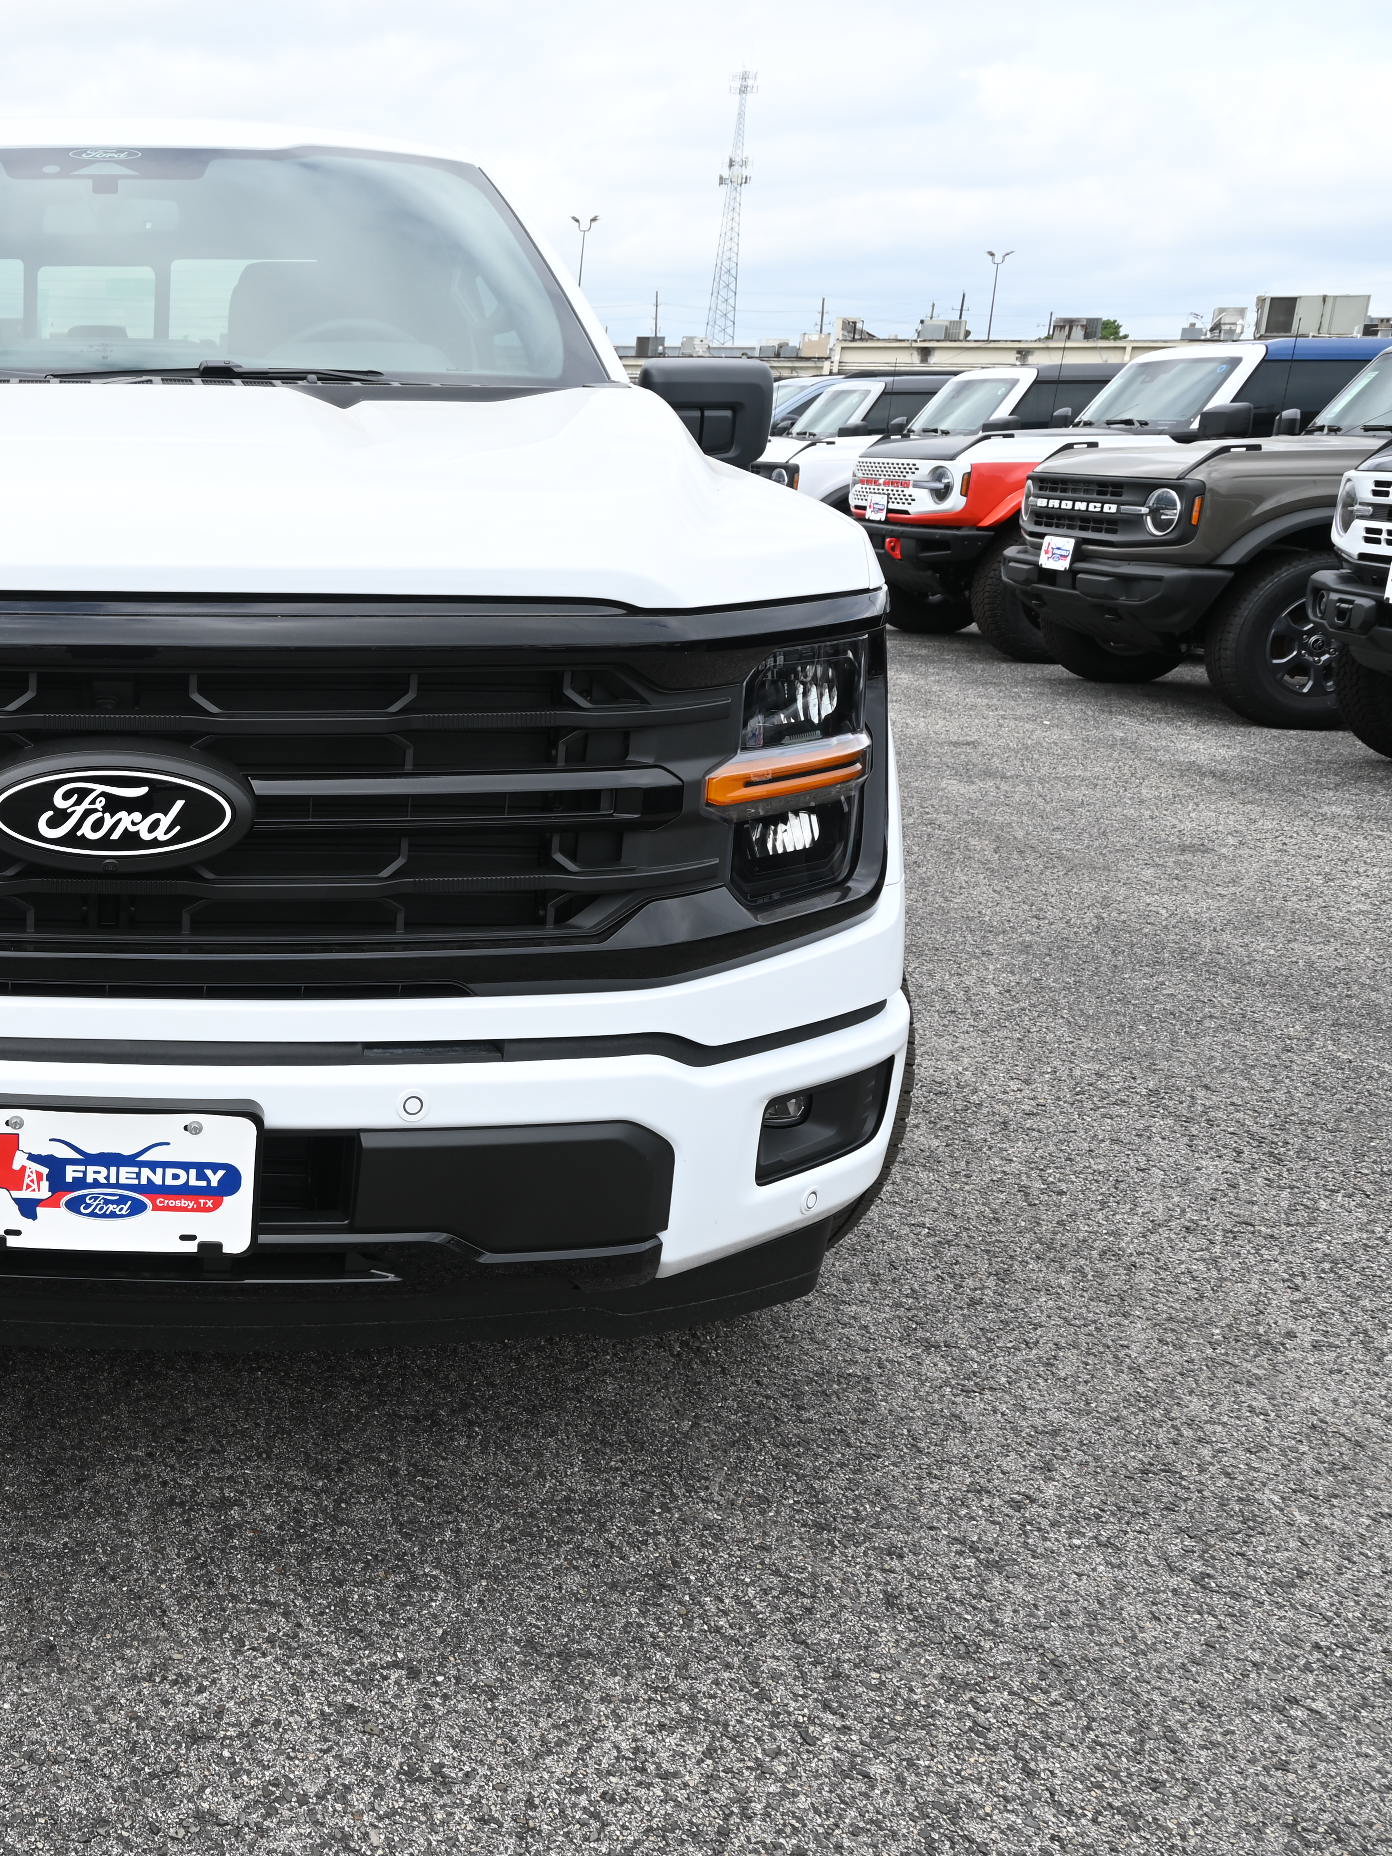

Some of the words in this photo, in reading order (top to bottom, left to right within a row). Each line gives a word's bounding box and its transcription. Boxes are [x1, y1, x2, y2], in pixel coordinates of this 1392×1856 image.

[81, 148, 129, 158] Ford
[1036, 498, 1118, 513] BRONCO
[37, 782, 186, 841] Ford
[65, 1165, 227, 1187] FRIENDLY
[80, 1194, 131, 1215] Ford
[156, 1198, 197, 1209] Crosby,
[199, 1199, 214, 1208] TX
